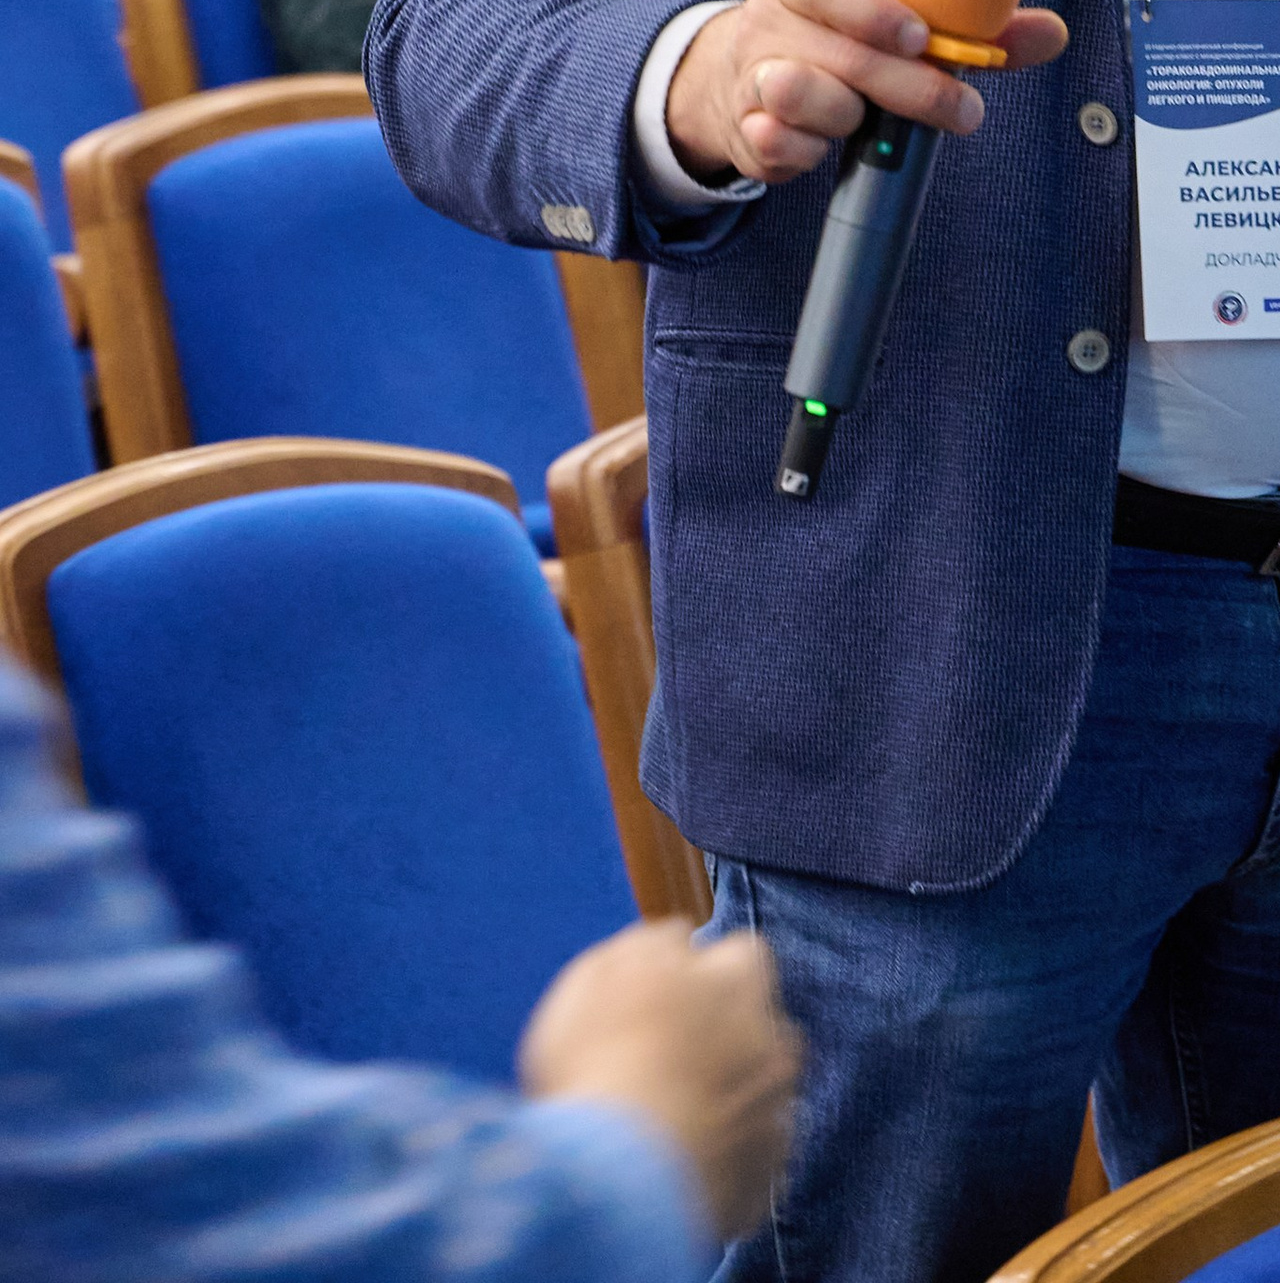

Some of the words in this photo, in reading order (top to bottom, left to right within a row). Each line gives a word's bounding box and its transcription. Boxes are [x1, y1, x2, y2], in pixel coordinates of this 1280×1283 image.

[1214, 80, 1265, 90] ОПУХОЛИ
[1147, 94, 1195, 106] ЛЕГКОГО
[1196, 94, 1205, 105] И
